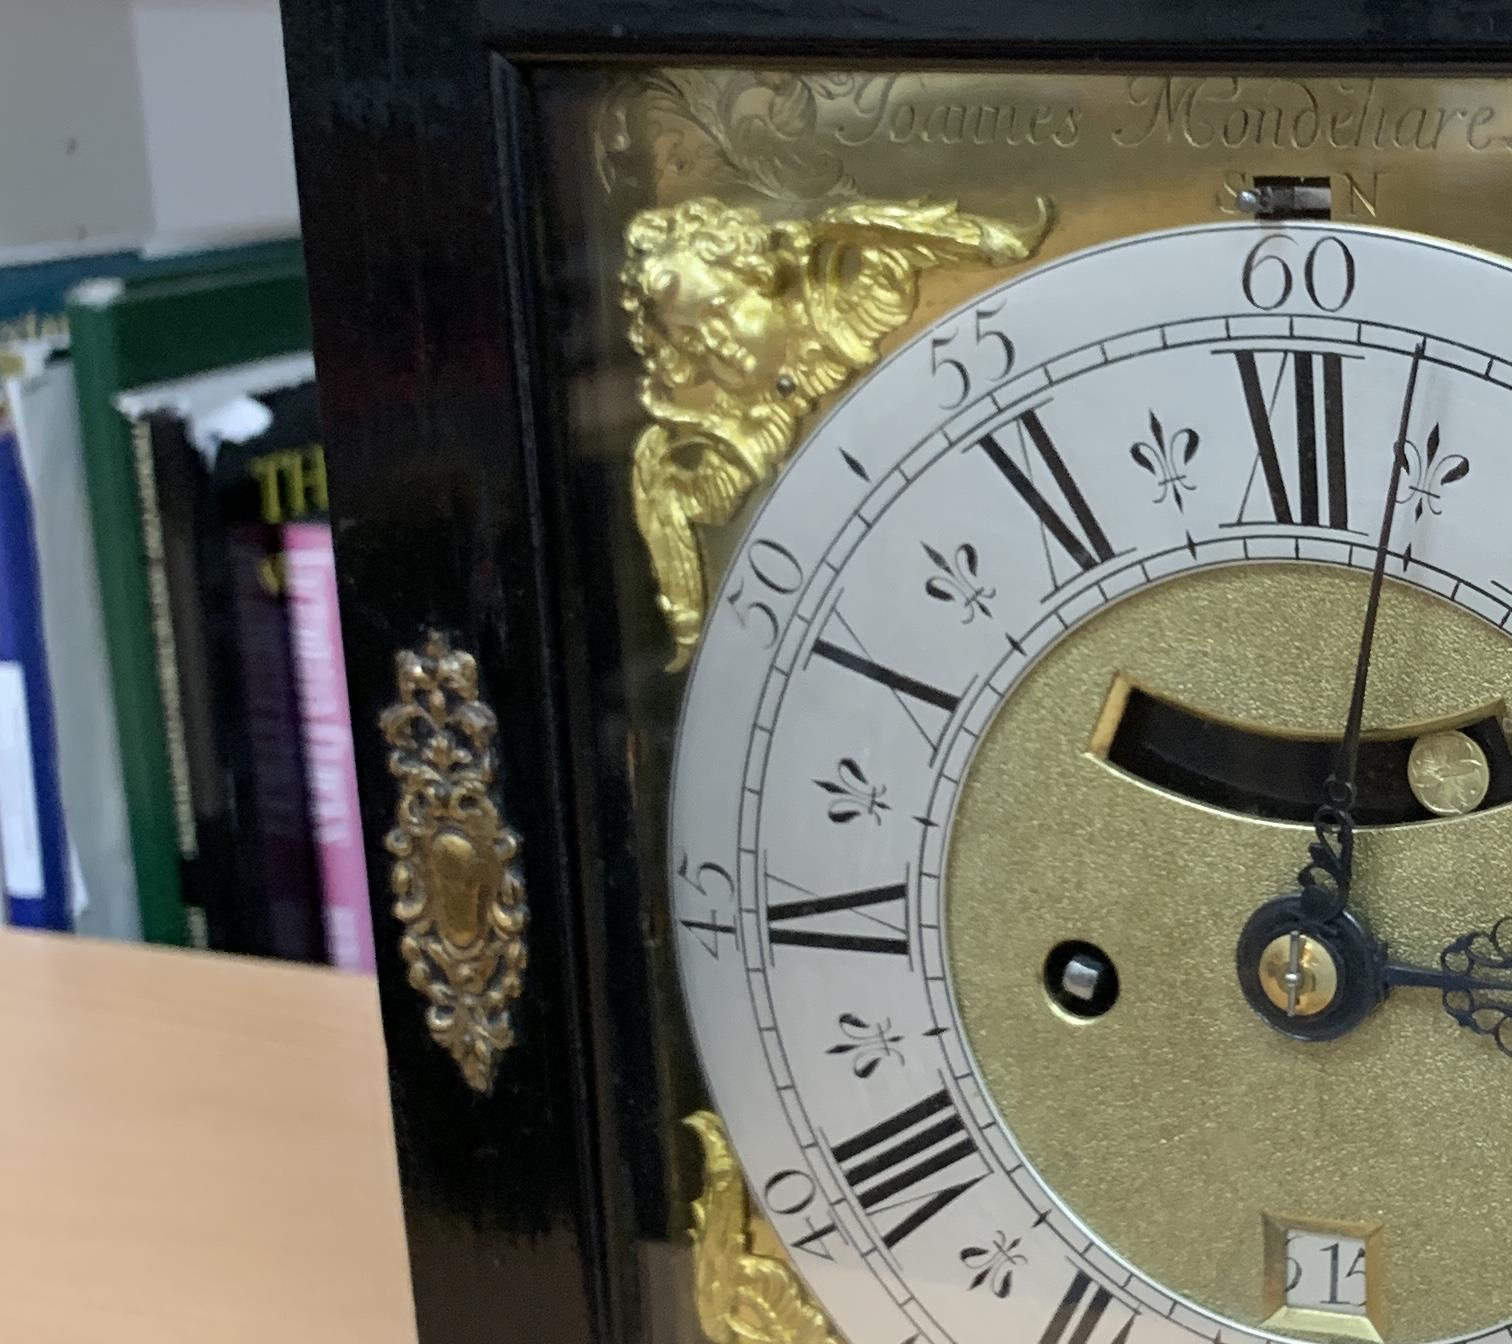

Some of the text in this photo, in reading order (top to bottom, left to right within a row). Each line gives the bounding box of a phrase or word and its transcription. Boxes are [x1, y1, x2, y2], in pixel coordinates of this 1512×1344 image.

[1340, 170, 1379, 218] N
[1241, 233, 1356, 313] 60
[928, 299, 1016, 411] 55
[1210, 348, 1369, 536] XII
[961, 397, 1138, 606] XI
[727, 538, 803, 649] 50
[802, 587, 980, 769] X
[678, 850, 742, 960] 45
[761, 1169, 848, 1263] 40
[818, 1067, 995, 1271] VIII
